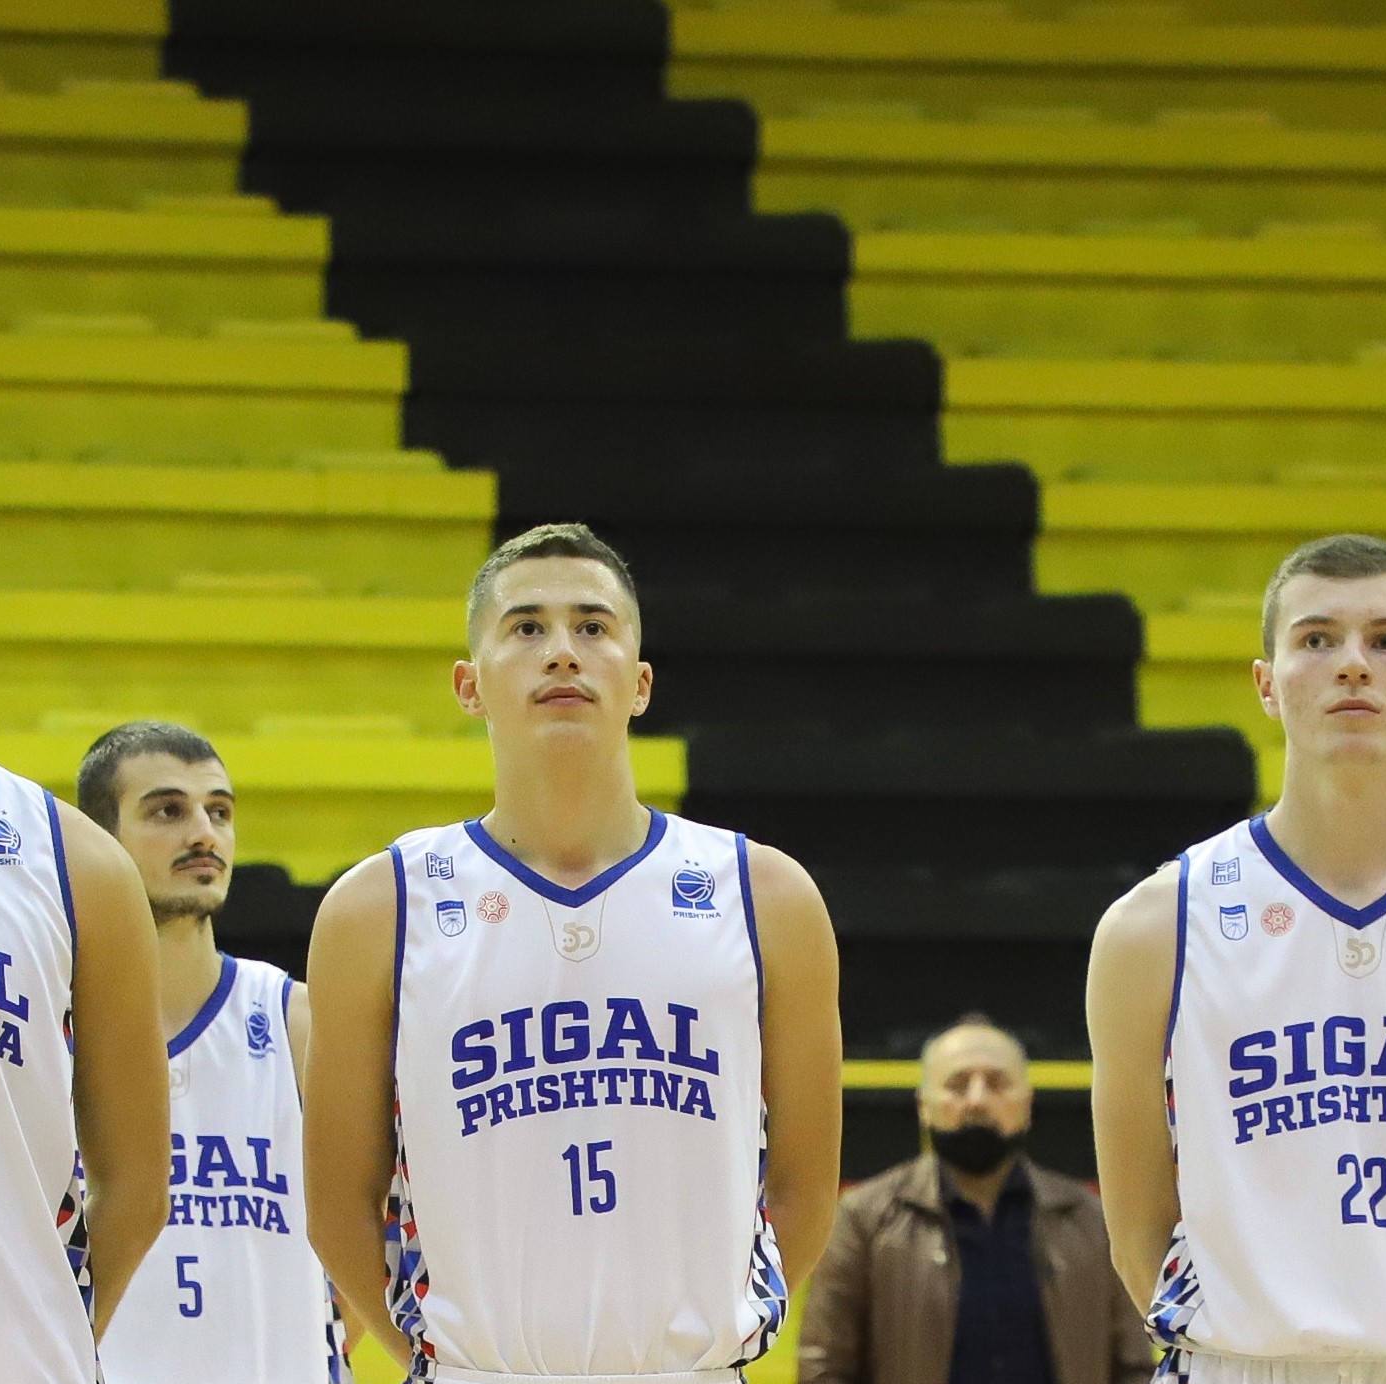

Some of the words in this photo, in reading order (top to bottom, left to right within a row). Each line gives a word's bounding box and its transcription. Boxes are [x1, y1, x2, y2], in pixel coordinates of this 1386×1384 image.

[673, 910, 722, 919] PRISHTINA
[452, 997, 719, 1089] SIGAL
[457, 1067, 716, 1136] PRISHTINA
[562, 1140, 618, 1216] 15
[167, 1194, 290, 1234] HTINA
[176, 1256, 203, 1318] 5
